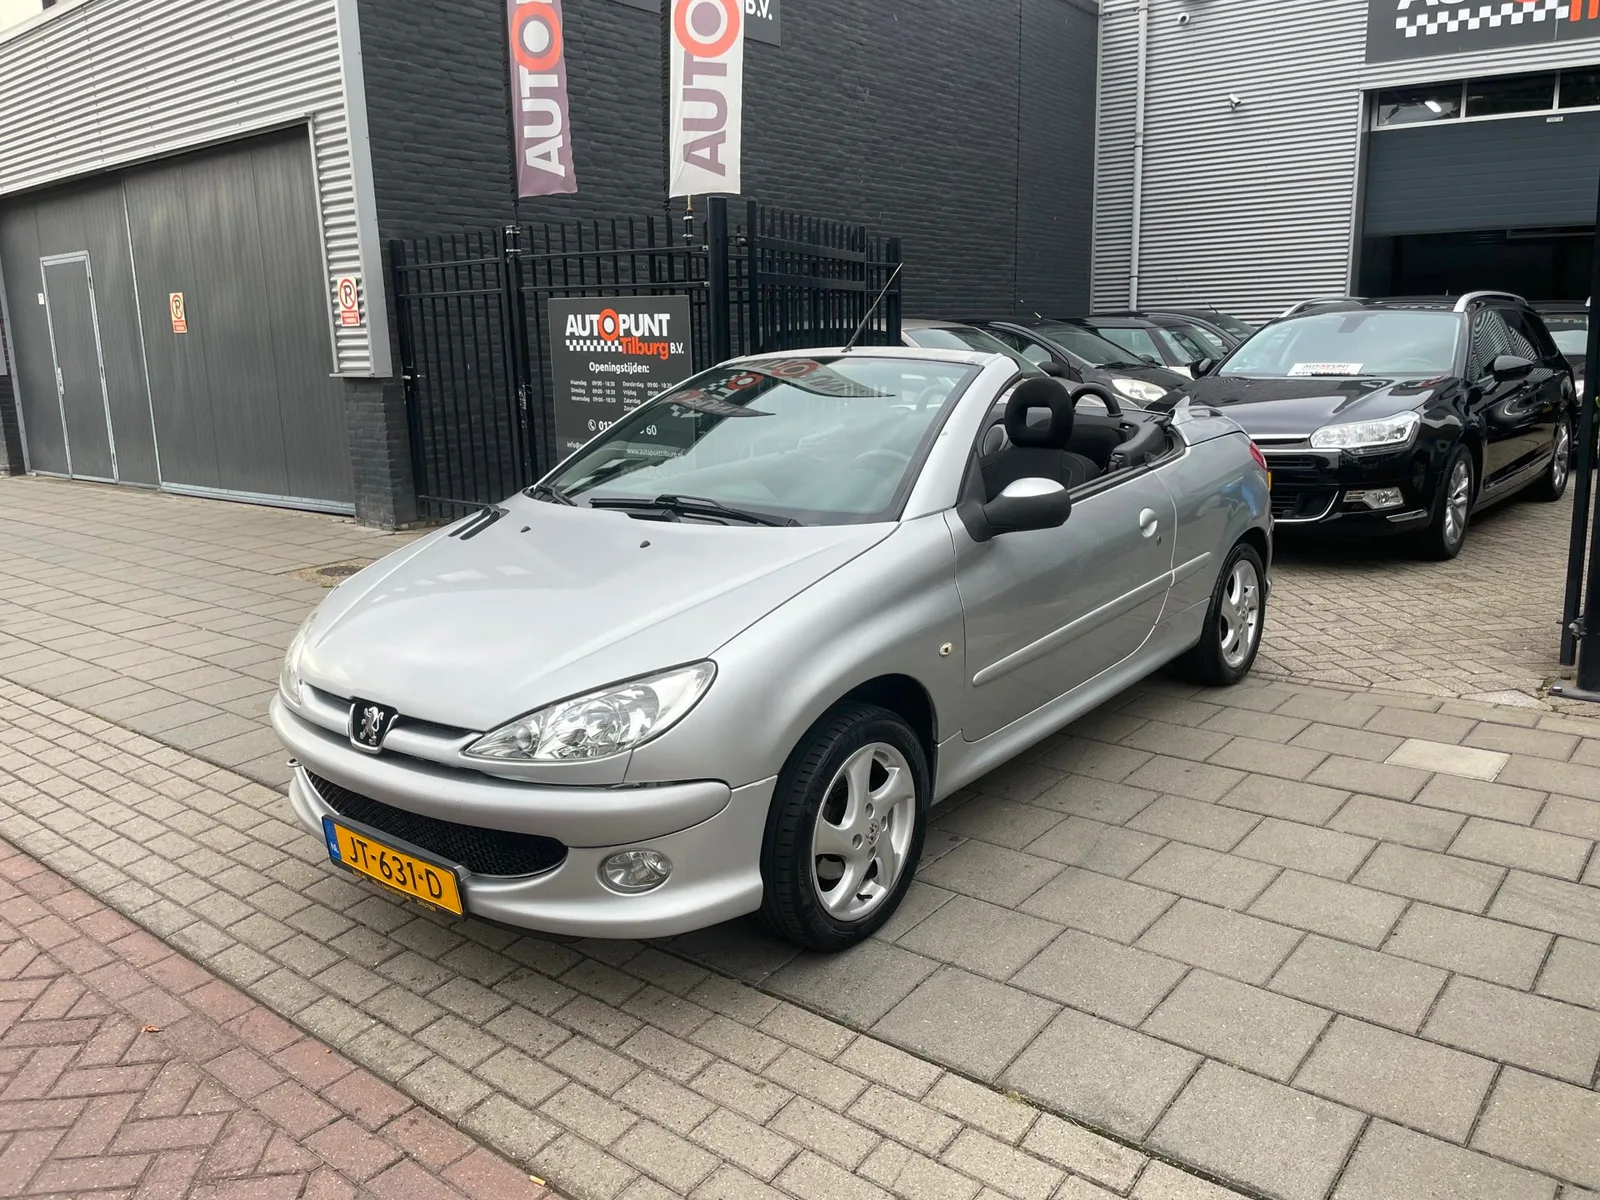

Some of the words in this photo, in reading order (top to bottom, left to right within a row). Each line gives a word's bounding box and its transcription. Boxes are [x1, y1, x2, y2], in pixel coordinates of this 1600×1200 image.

[511, 0, 565, 177] AUTO
[565, 308, 671, 341] AUTOPUNT
[620, 337, 669, 360] Tilburg
[670, 342, 685, 354] B.V.
[588, 362, 650, 374] Openingstijden:
[646, 424, 657, 436] 60
[350, 836, 443, 899] JT-631-D
